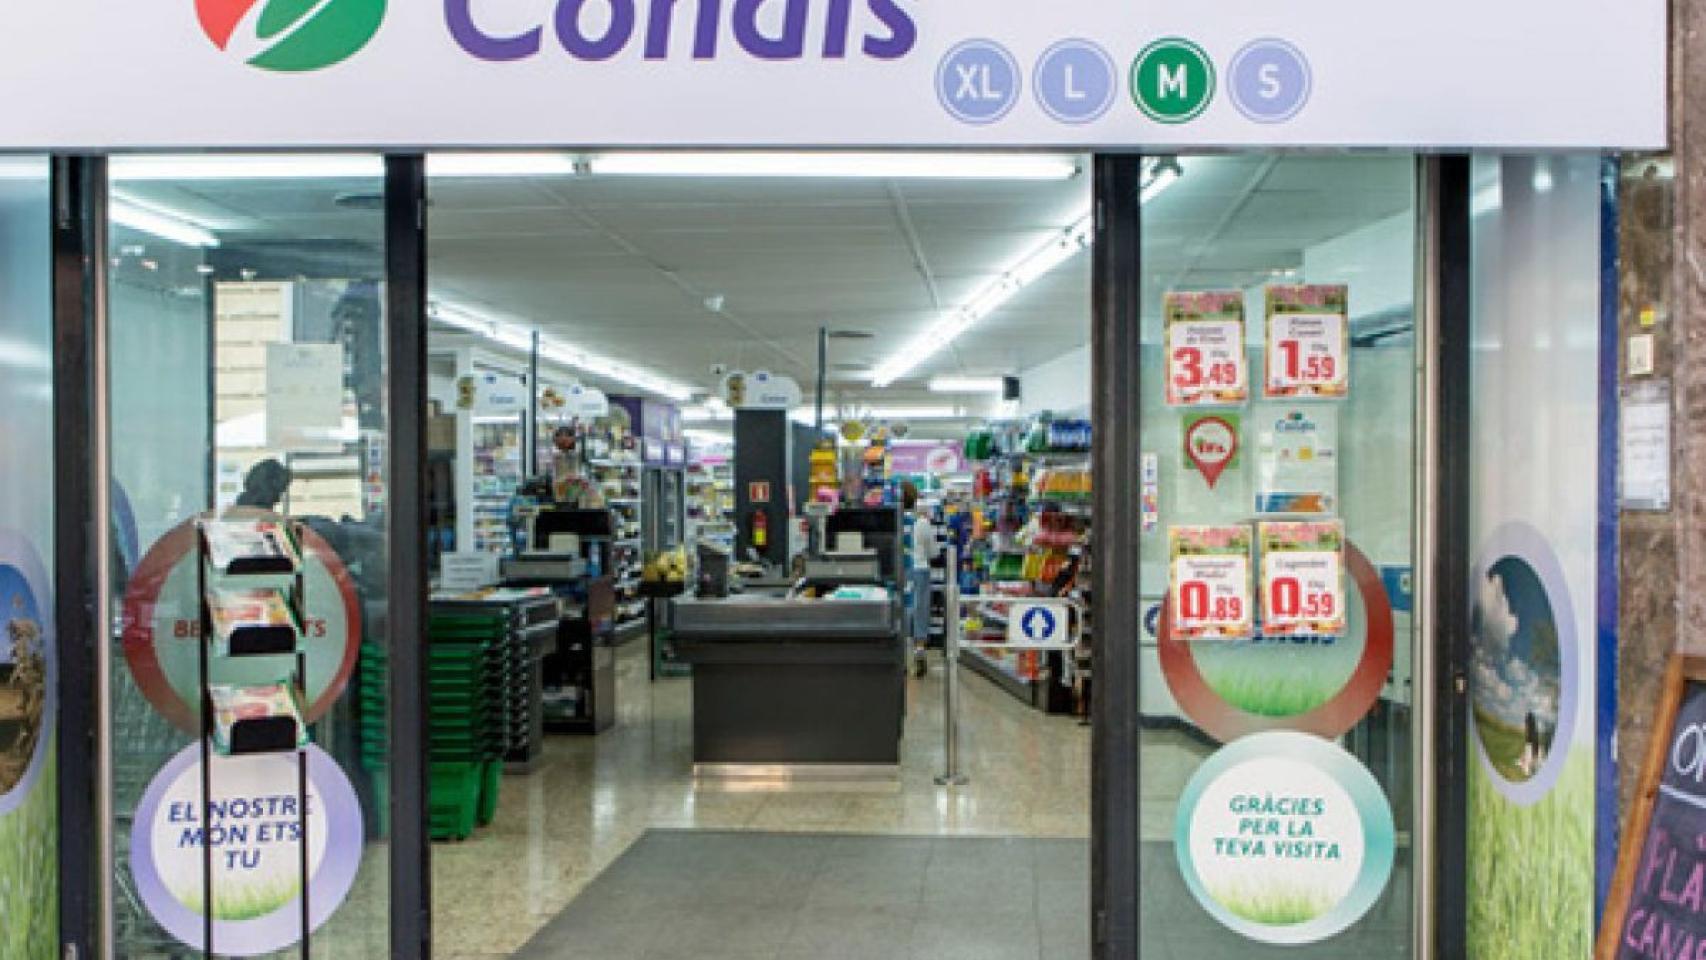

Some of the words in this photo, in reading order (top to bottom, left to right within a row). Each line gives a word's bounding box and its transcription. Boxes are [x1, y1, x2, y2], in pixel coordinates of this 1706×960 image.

[955, 63, 1001, 99] XL
[1064, 63, 1085, 99] L
[1157, 63, 1188, 99] M
[1258, 63, 1281, 99] S
[168, 801, 198, 822] EL
[1228, 792, 1326, 815] GRÀCIES
[256, 820, 304, 842] ETS
[1238, 817, 1280, 835] PER
[1287, 819, 1314, 836] LA
[224, 847, 261, 868] TU
[1213, 837, 1266, 856] TEVA
[1274, 840, 1341, 859] VISITA
